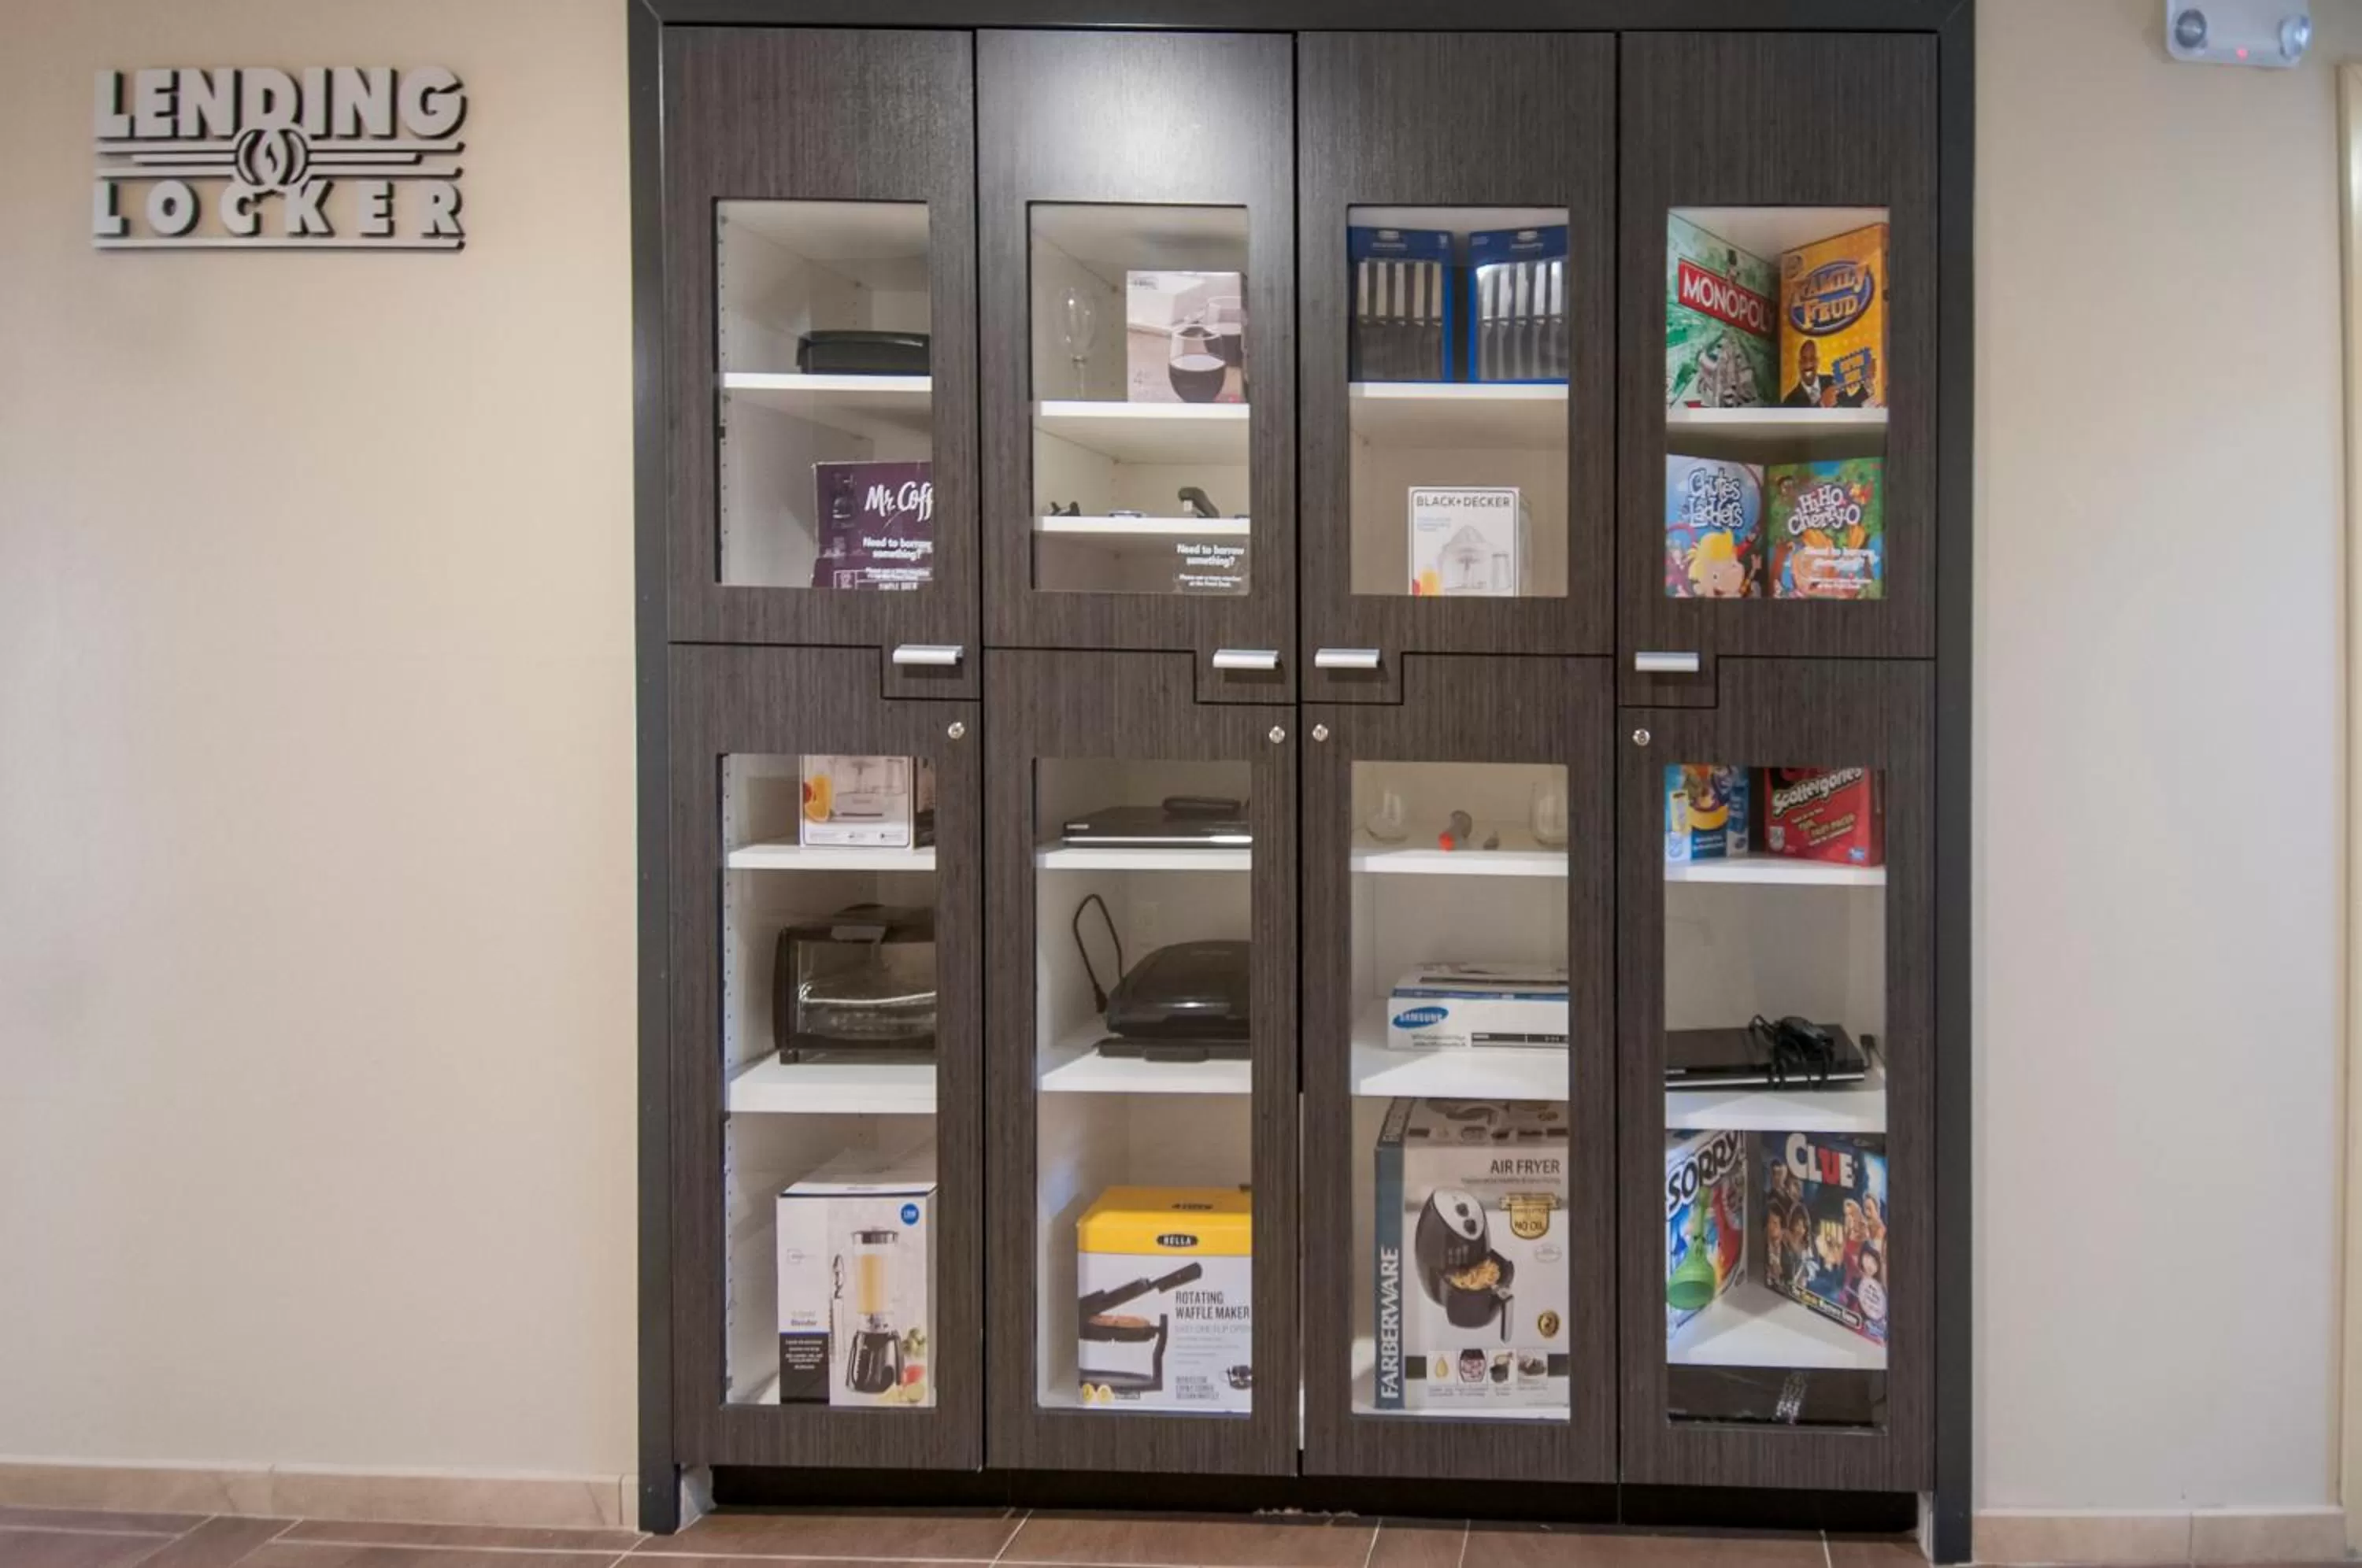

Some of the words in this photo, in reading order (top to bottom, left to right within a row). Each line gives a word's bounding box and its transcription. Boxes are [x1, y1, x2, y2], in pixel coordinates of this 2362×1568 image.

[94, 65, 467, 141] LENDING
[93, 179, 466, 238] LOCKER
[1792, 262, 1868, 305] FAMILY
[1802, 296, 1857, 329] FEUD
[1176, 544, 1200, 554] Need
[1201, 545, 1212, 554] to
[1398, 1012, 1443, 1023] SAMSUNG
[1490, 1158, 1513, 1174] AIR
[1516, 1158, 1560, 1174] FRYER
[1785, 1132, 1855, 1189] CLUE
[1163, 1236, 1192, 1245] BELLA
[1175, 1290, 1224, 1304] ROTATING
[1175, 1305, 1213, 1320] WAFFLE
[1215, 1305, 1250, 1320] MAKER
[1380, 1246, 1399, 1399] FARBERWARE
